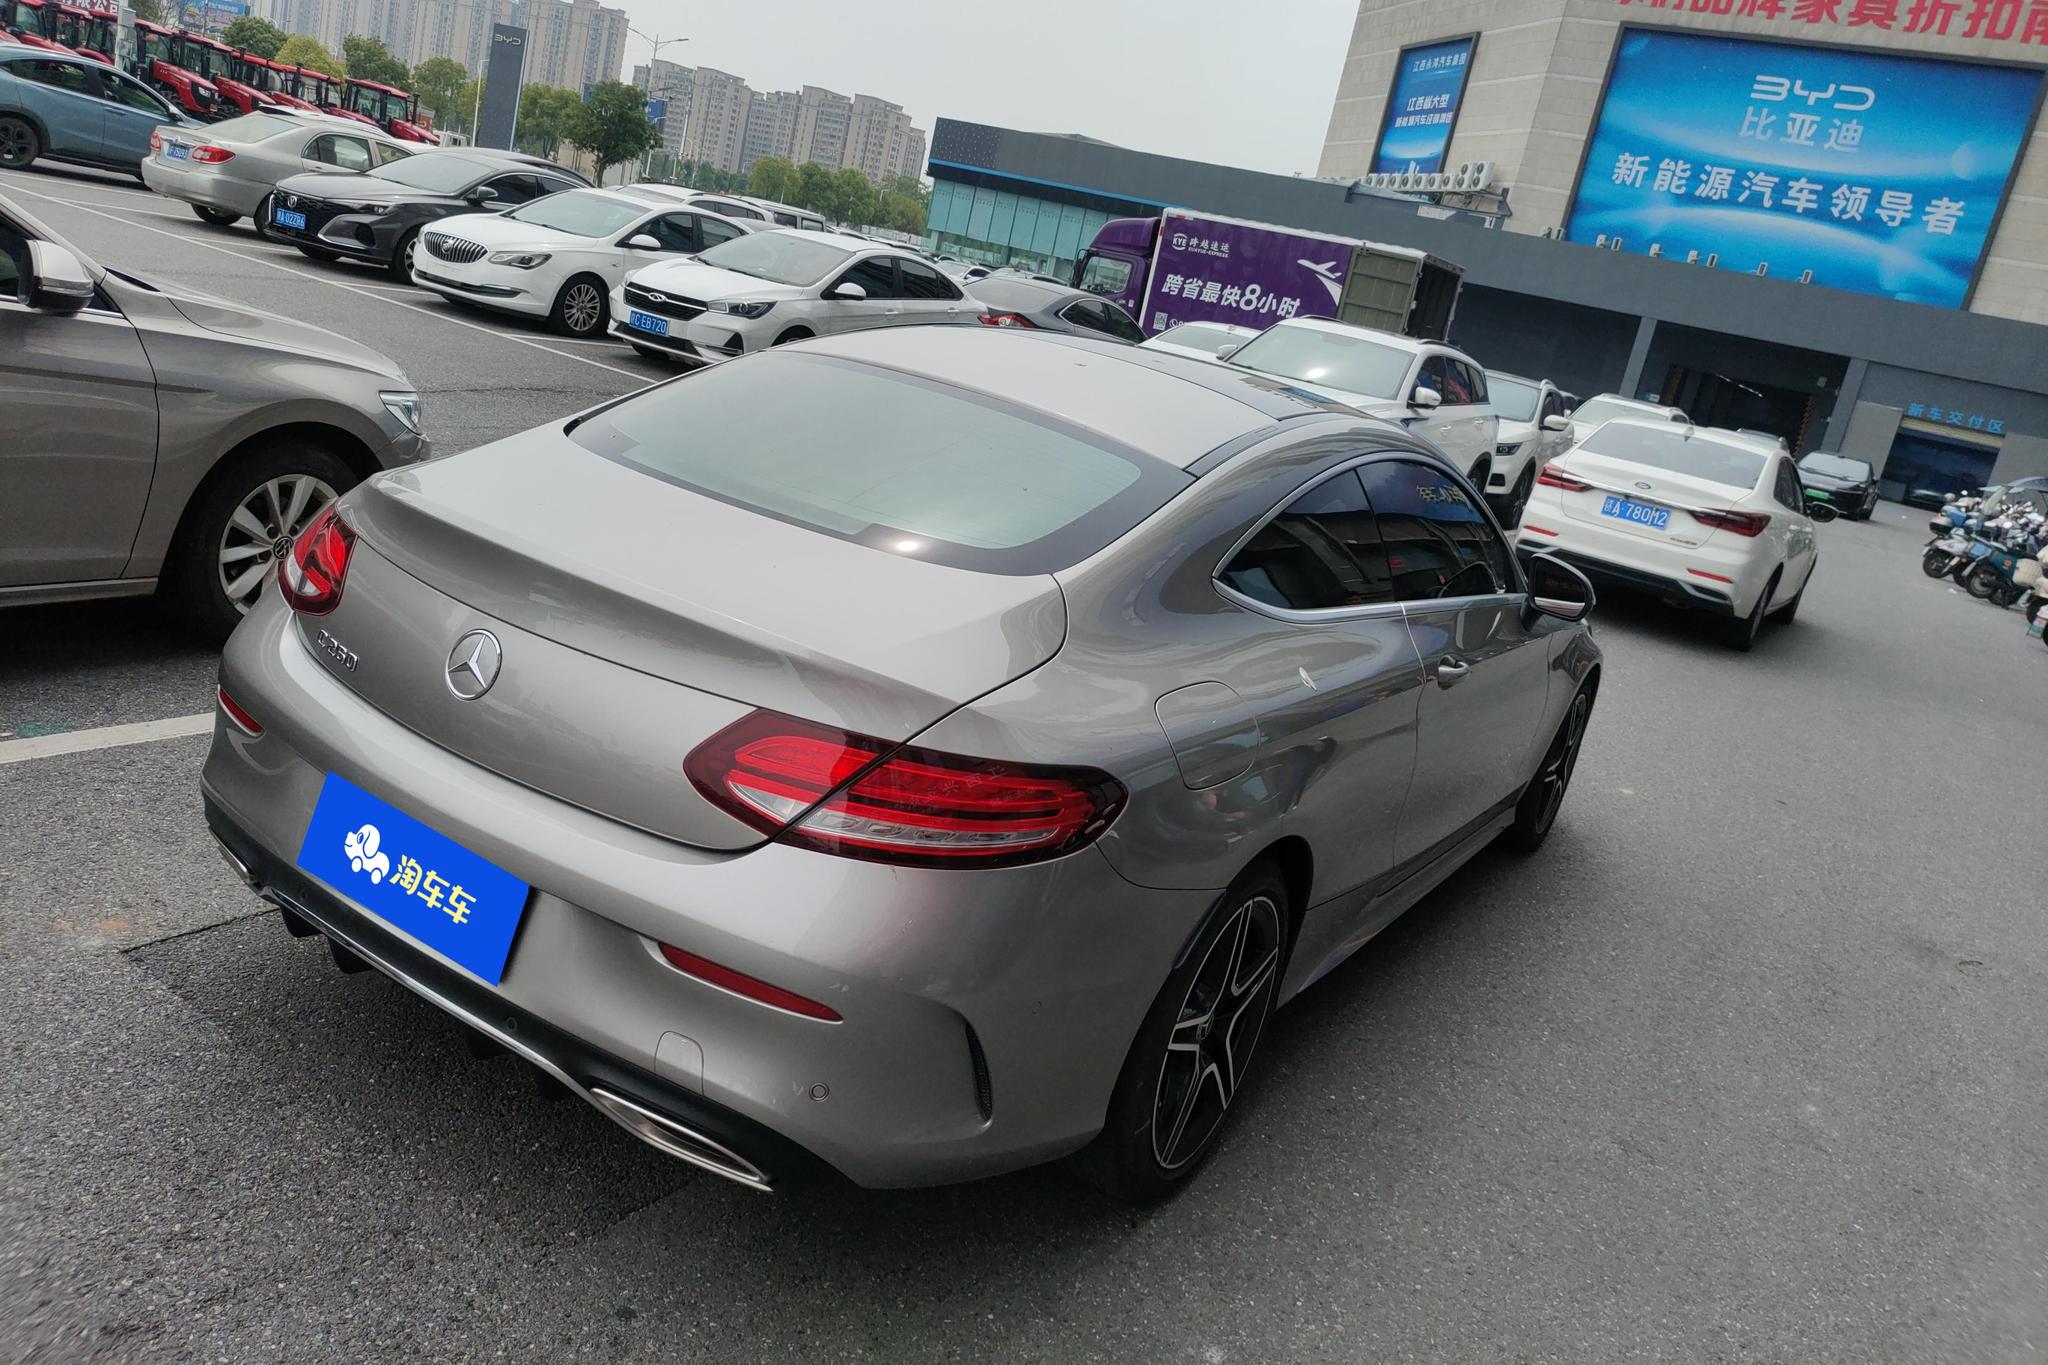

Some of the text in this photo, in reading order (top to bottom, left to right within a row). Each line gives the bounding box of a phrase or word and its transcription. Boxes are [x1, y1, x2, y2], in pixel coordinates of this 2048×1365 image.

[495, 33, 521, 45] BYD
[1750, 75, 1875, 111] BYD
[1739, 106, 1864, 153] 比亚迪
[1612, 152, 1965, 235] 新能源汽车领导者
[1161, 273, 1301, 318] 跨省最快8小时
[1908, 402, 2005, 423] 新车交付区
[317, 629, 358, 672] C260
